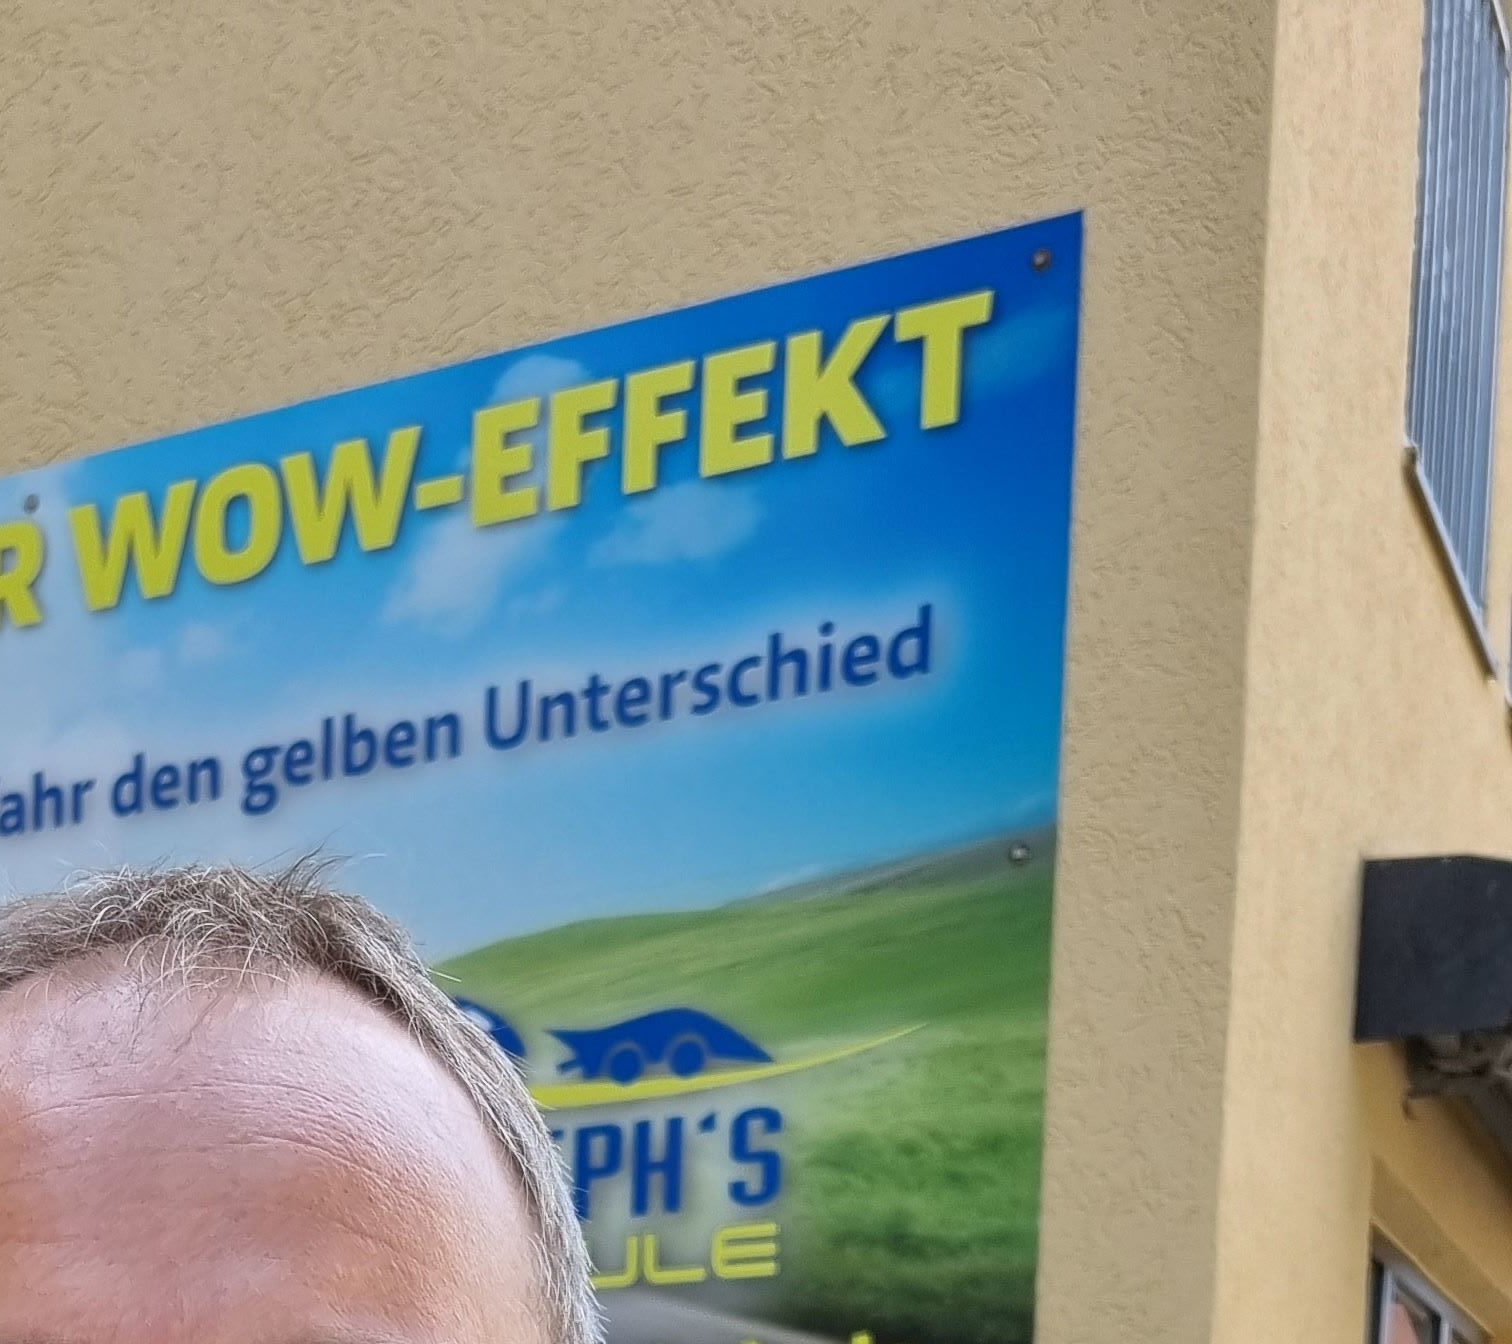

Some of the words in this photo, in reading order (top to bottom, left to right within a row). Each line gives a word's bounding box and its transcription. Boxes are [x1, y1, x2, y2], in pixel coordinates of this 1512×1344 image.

[69, 291, 994, 611] WOW-EFFEKT
[110, 752, 222, 818] den
[241, 711, 463, 816] gelben
[484, 602, 934, 750] Unterschied
